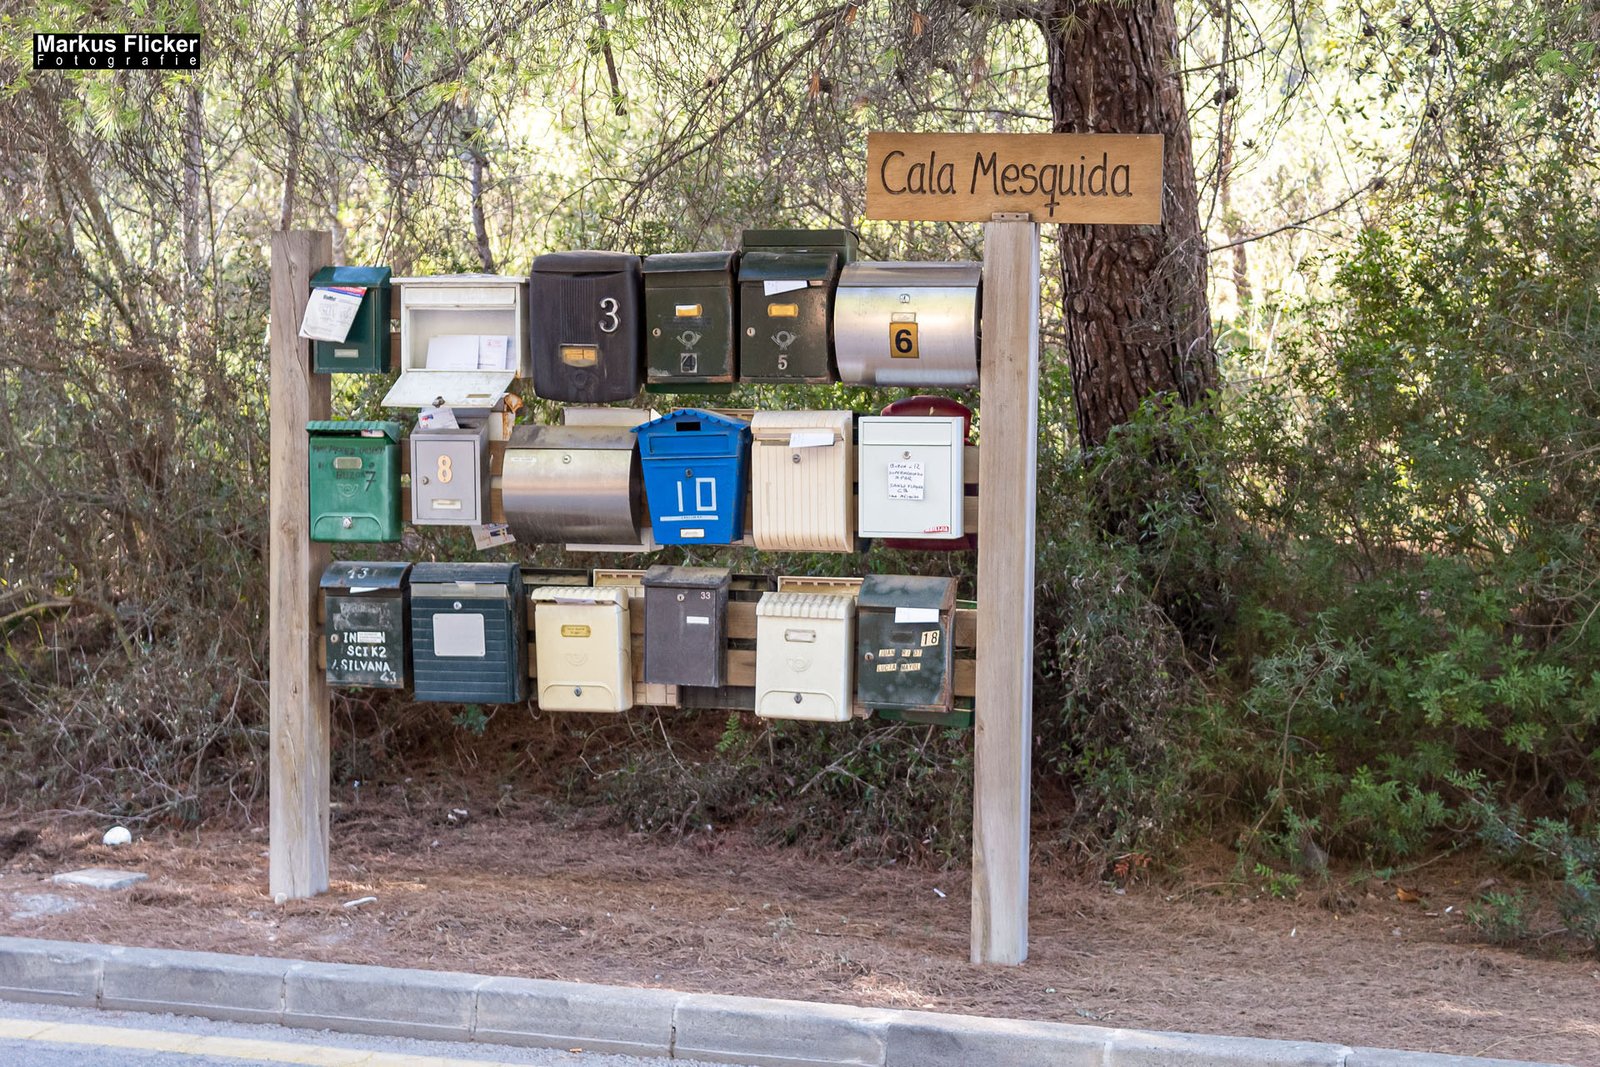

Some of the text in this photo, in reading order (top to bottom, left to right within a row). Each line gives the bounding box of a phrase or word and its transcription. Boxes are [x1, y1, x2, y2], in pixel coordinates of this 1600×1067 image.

[881, 150, 1133, 217] Cala Mesquida
[599, 297, 620, 333] 3
[895, 329, 912, 353] 6
[681, 354, 696, 372] 4
[777, 354, 788, 370] 5
[437, 454, 452, 484] 8
[364, 471, 376, 492] 7
[676, 477, 717, 512] 10
[700, 591, 711, 600] 33
[923, 631, 938, 645] 18
[341, 658, 391, 672] SILVANA
